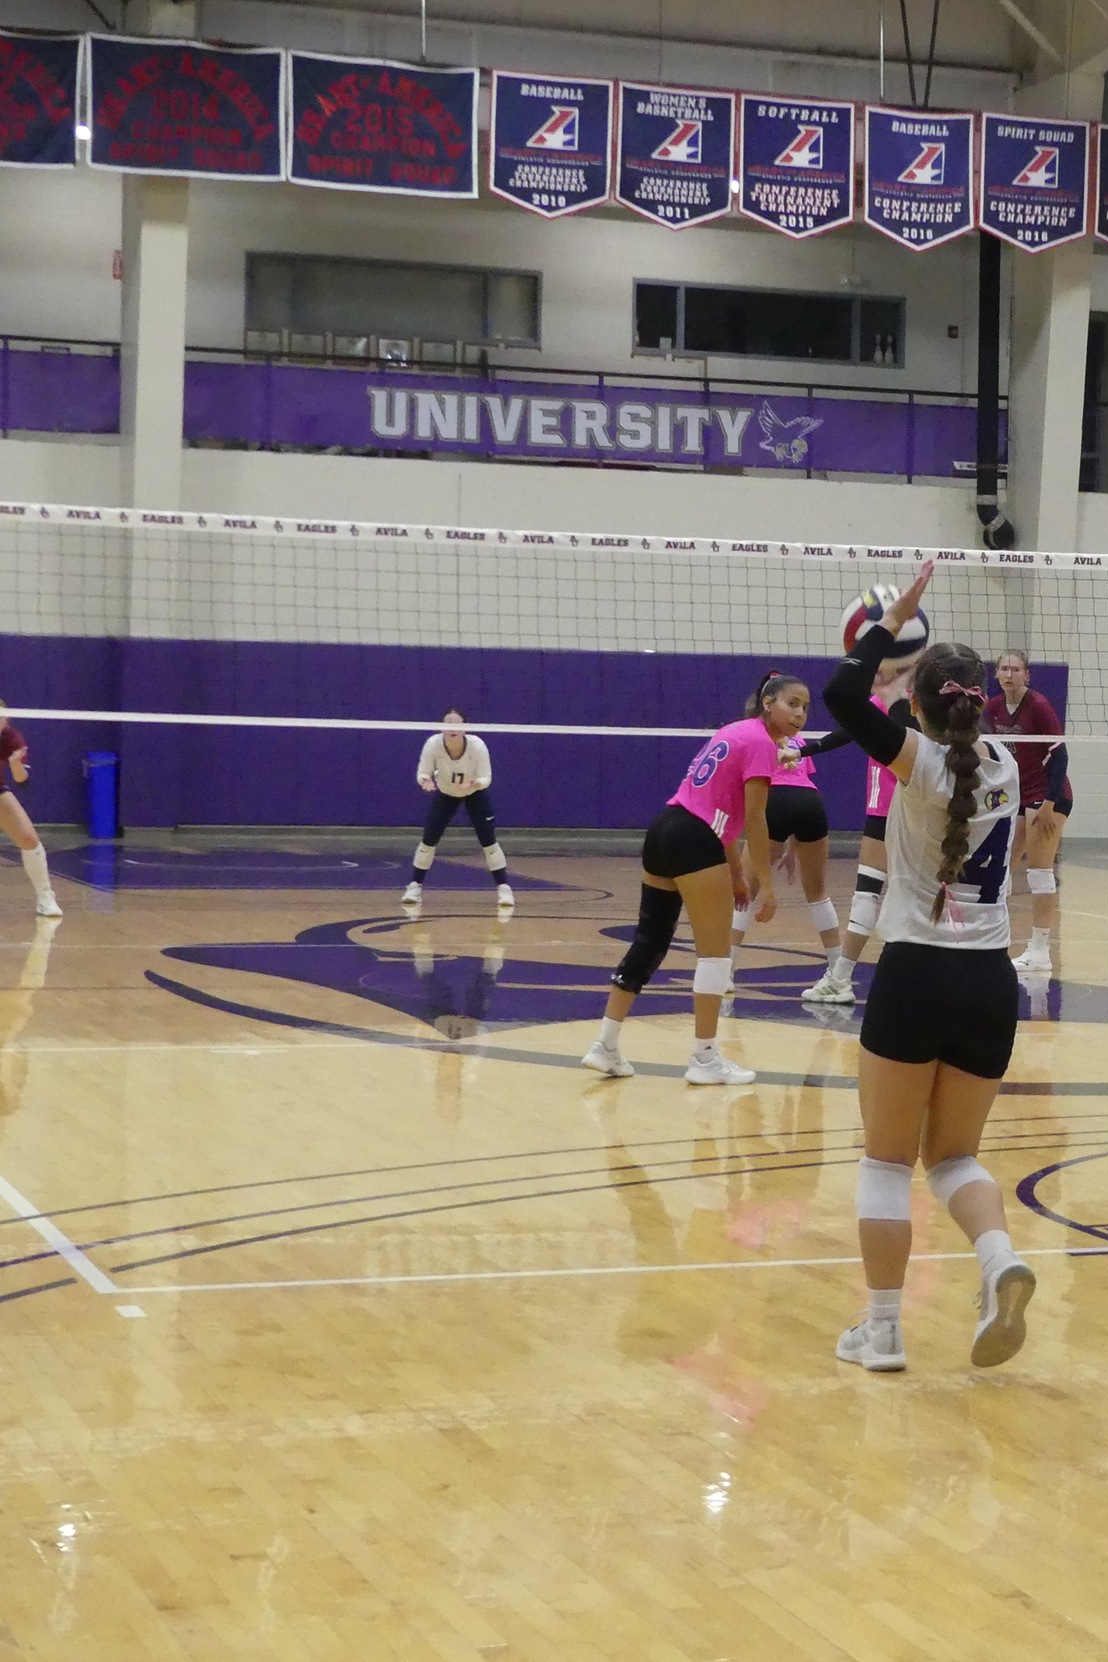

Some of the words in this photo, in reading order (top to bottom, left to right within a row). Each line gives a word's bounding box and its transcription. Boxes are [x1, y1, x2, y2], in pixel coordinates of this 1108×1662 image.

[520, 83, 584, 100] BASEBALL
[346, 103, 414, 136] 2015
[637, 102, 714, 121] BASKETBALL
[758, 105, 838, 123] SOFTBALL
[892, 120, 949, 136] BASEBALL
[997, 125, 1035, 140] SPIRIT
[1038, 130, 1074, 143] SQUAD
[517, 164, 584, 179] CONFERENCE
[643, 176, 708, 191] CONFERENCE
[755, 183, 839, 200] CONFERENCE
[532, 193, 566, 207] 2010
[874, 197, 961, 213] CONFERENCE
[658, 205, 690, 219] 2011
[760, 202, 828, 216] CHAMPION
[883, 208, 953, 223] CHAMPION
[990, 201, 1076, 218] CONFERENCE
[779, 215, 814, 228] 2015
[999, 212, 1067, 227] CHAMPION
[368, 387, 753, 456] UNIVERSITY
[67, 509, 102, 520] AVILA
[142, 514, 184, 525] EAGLES
[224, 519, 257, 529] AVILA
[297, 523, 337, 534] EAGLES
[375, 526, 408, 537] AVILA
[446, 530, 485, 541] EAGLES
[522, 534, 554, 544] AVILA
[591, 537, 629, 547] EAGLES
[665, 540, 696, 550] AVILA
[732, 543, 768, 553] EAGLES
[803, 547, 833, 556] AVILA
[867, 549, 903, 559] EAGLES
[937, 551, 966, 561] AVILA
[999, 554, 1034, 564] EAGLES
[1073, 557, 1102, 566] AVILA
[451, 772, 465, 784] 17
